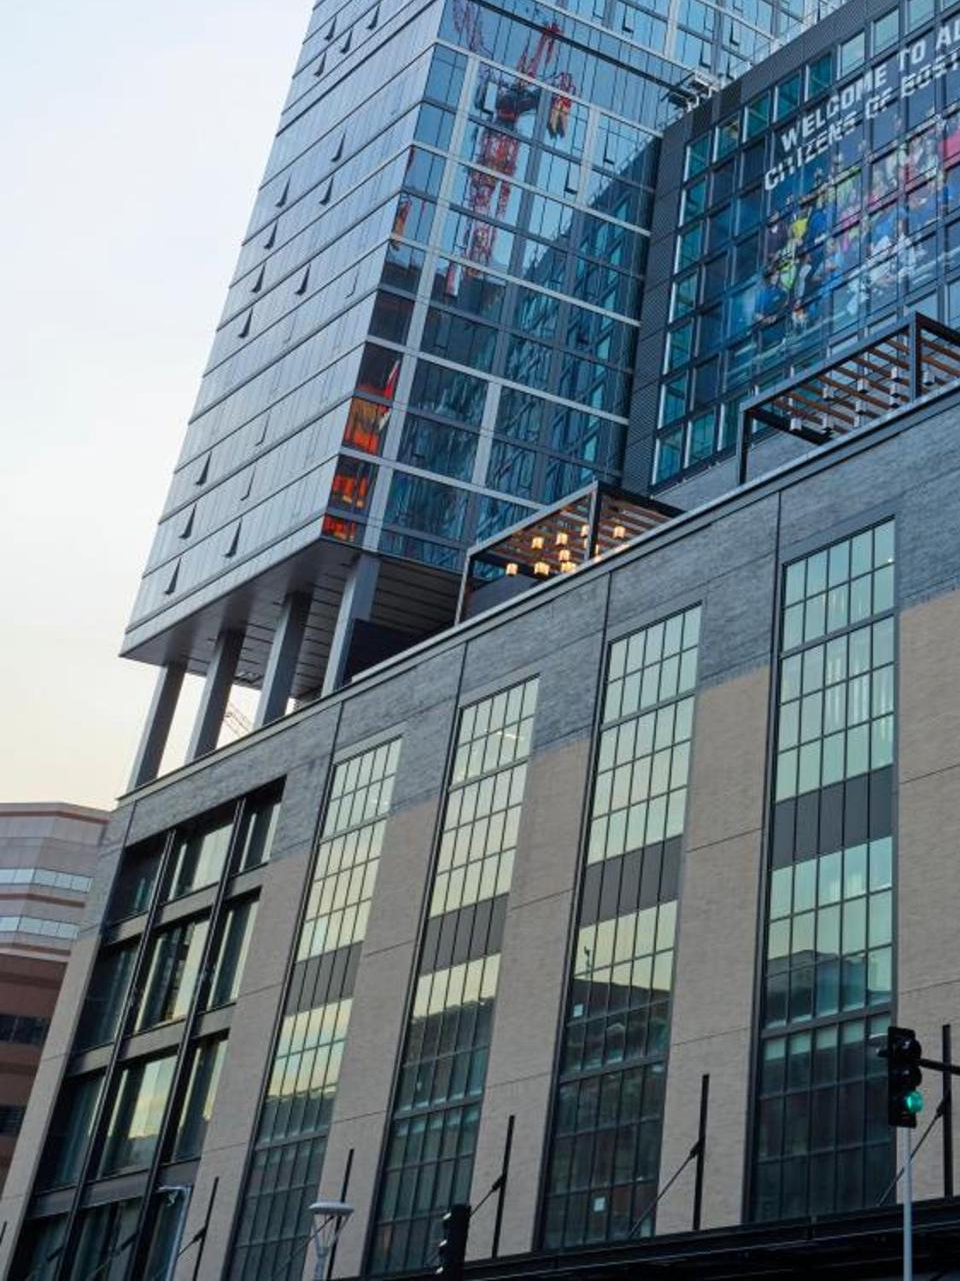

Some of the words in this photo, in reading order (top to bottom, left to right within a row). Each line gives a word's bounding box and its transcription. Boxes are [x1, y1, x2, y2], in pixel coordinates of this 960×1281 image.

[764, 108, 858, 191] CITIZENS
[865, 86, 893, 120] OF
[780, 63, 889, 153] WELCOME
[899, 40, 926, 69] TO
